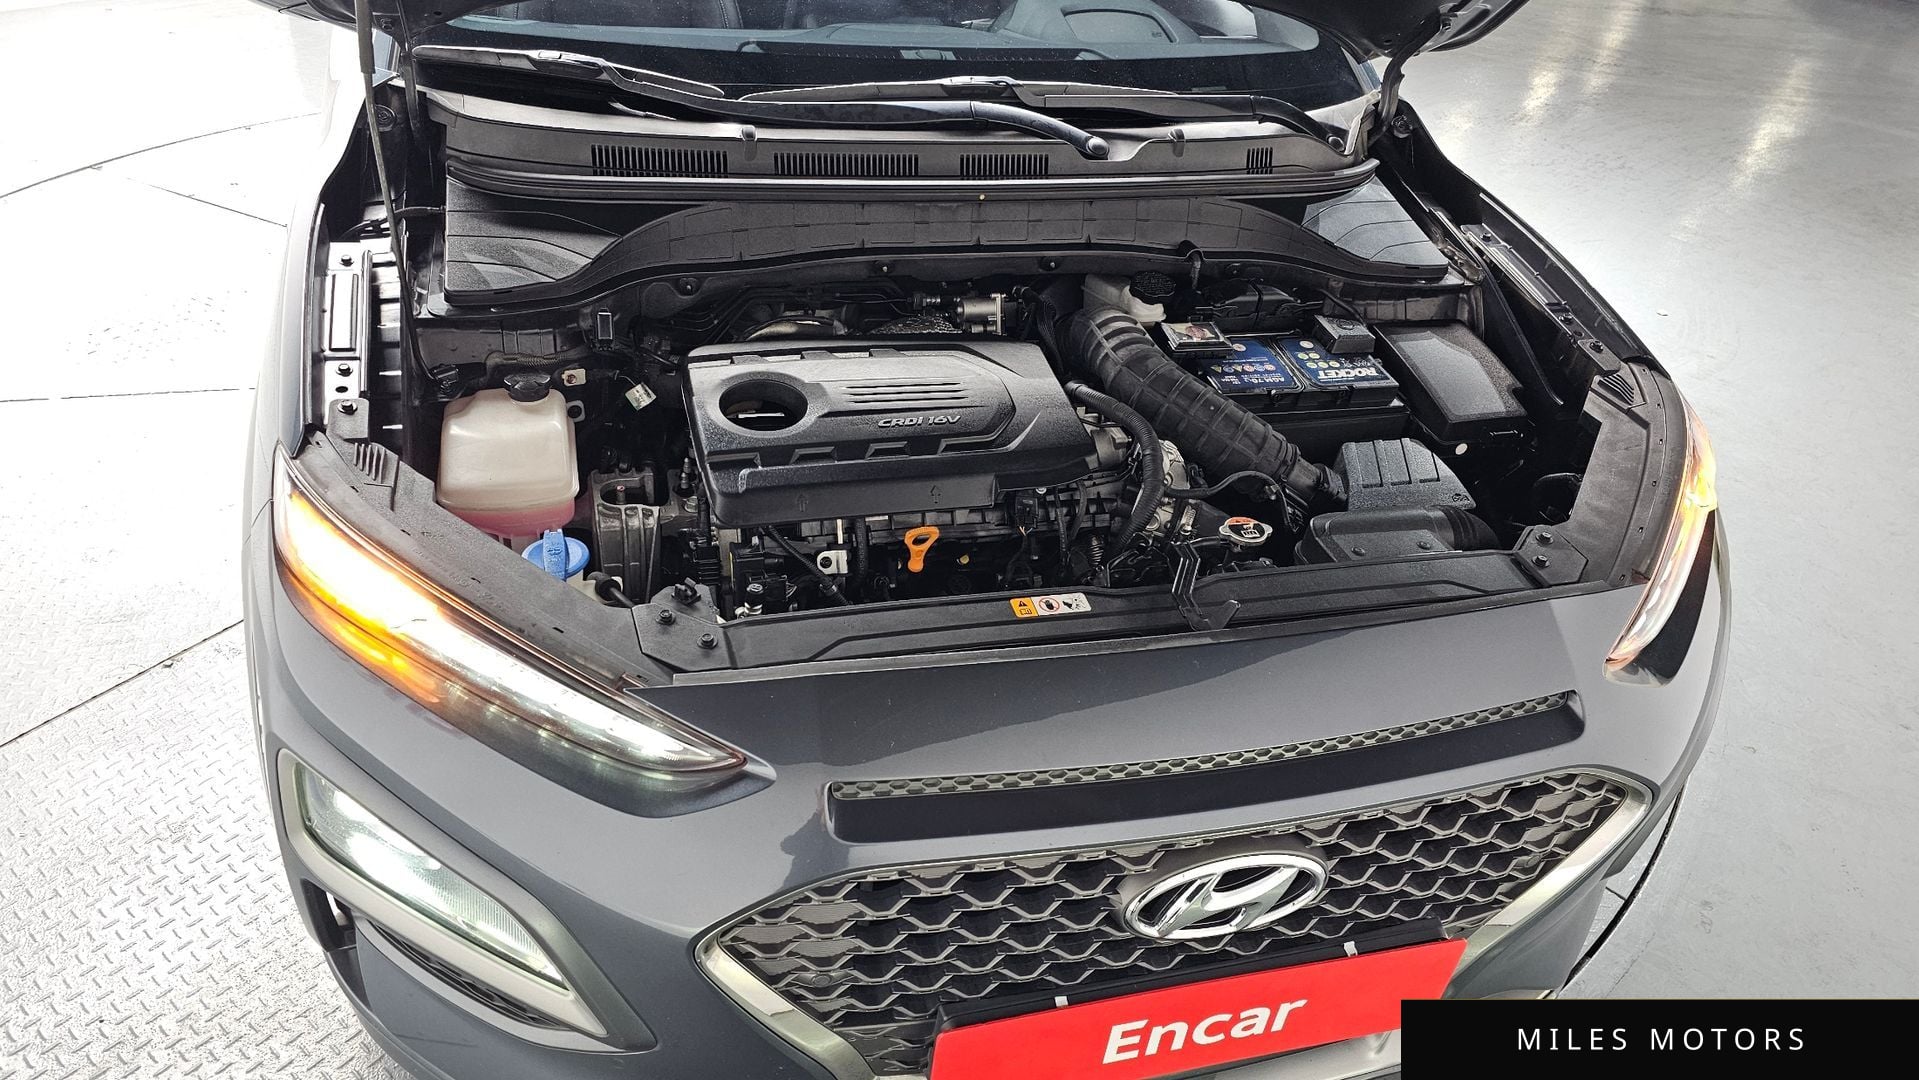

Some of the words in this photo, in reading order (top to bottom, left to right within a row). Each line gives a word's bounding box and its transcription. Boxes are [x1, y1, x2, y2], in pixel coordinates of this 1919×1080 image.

[1318, 367, 1379, 379] ROCKET
[927, 415, 961, 424] 16V
[1102, 999, 1308, 1064] Encar
